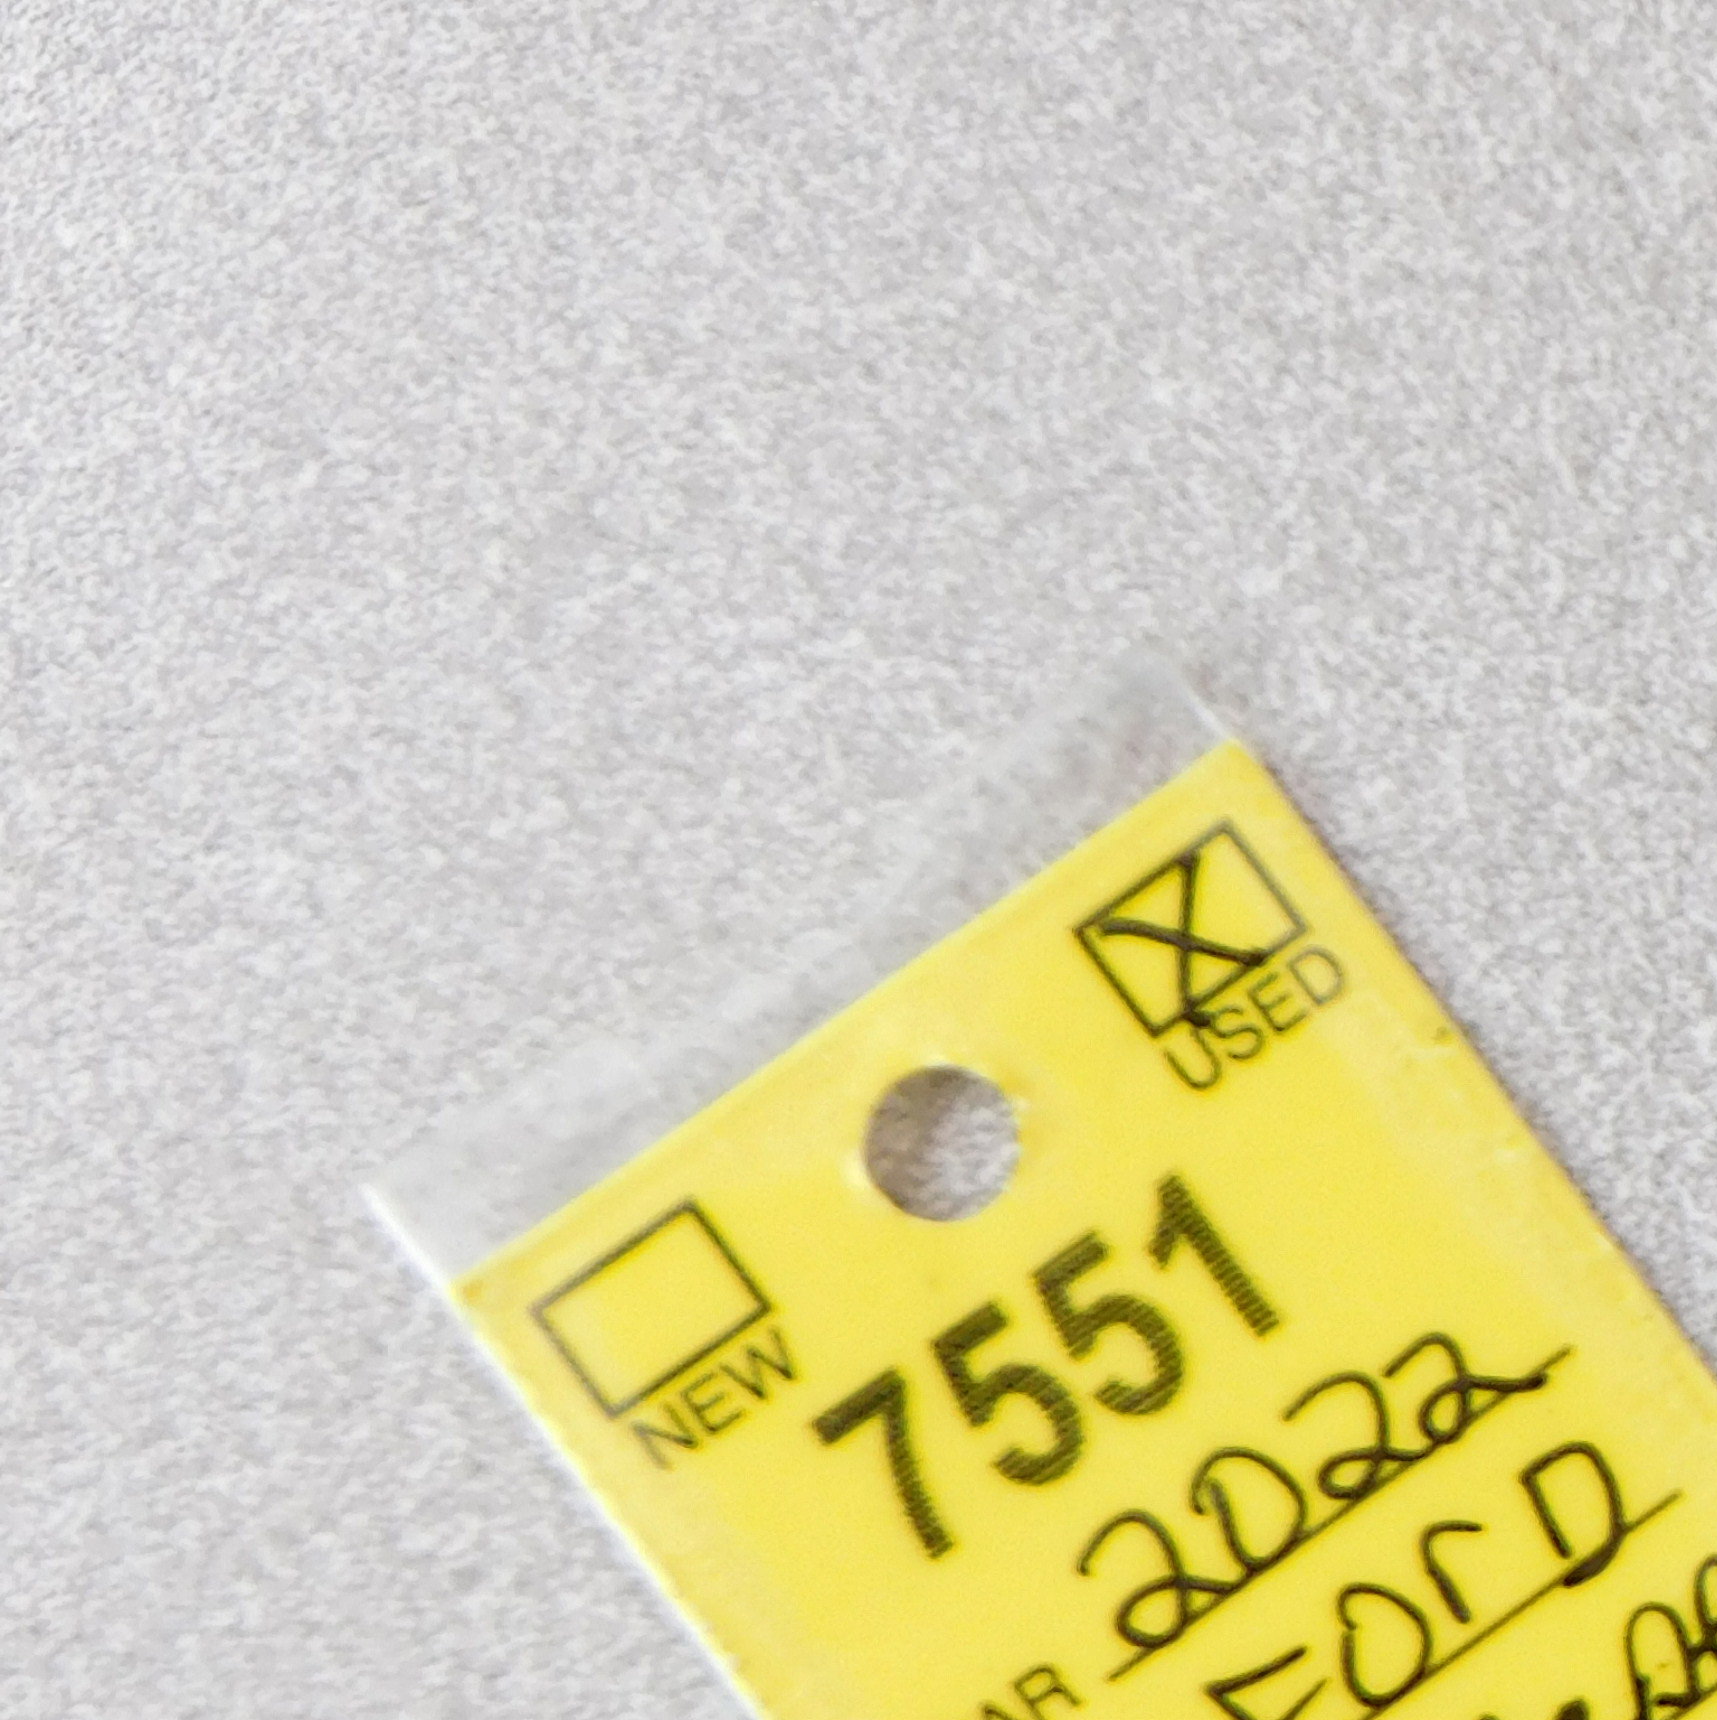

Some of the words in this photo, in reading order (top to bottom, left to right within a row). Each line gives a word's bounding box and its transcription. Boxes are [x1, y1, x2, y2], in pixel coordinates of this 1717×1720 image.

[1165, 945, 1346, 1091] USED
[630, 1325, 797, 1470] NEW
[812, 1172, 1281, 1560] 7551
[1077, 1330, 1548, 1650] 2022
